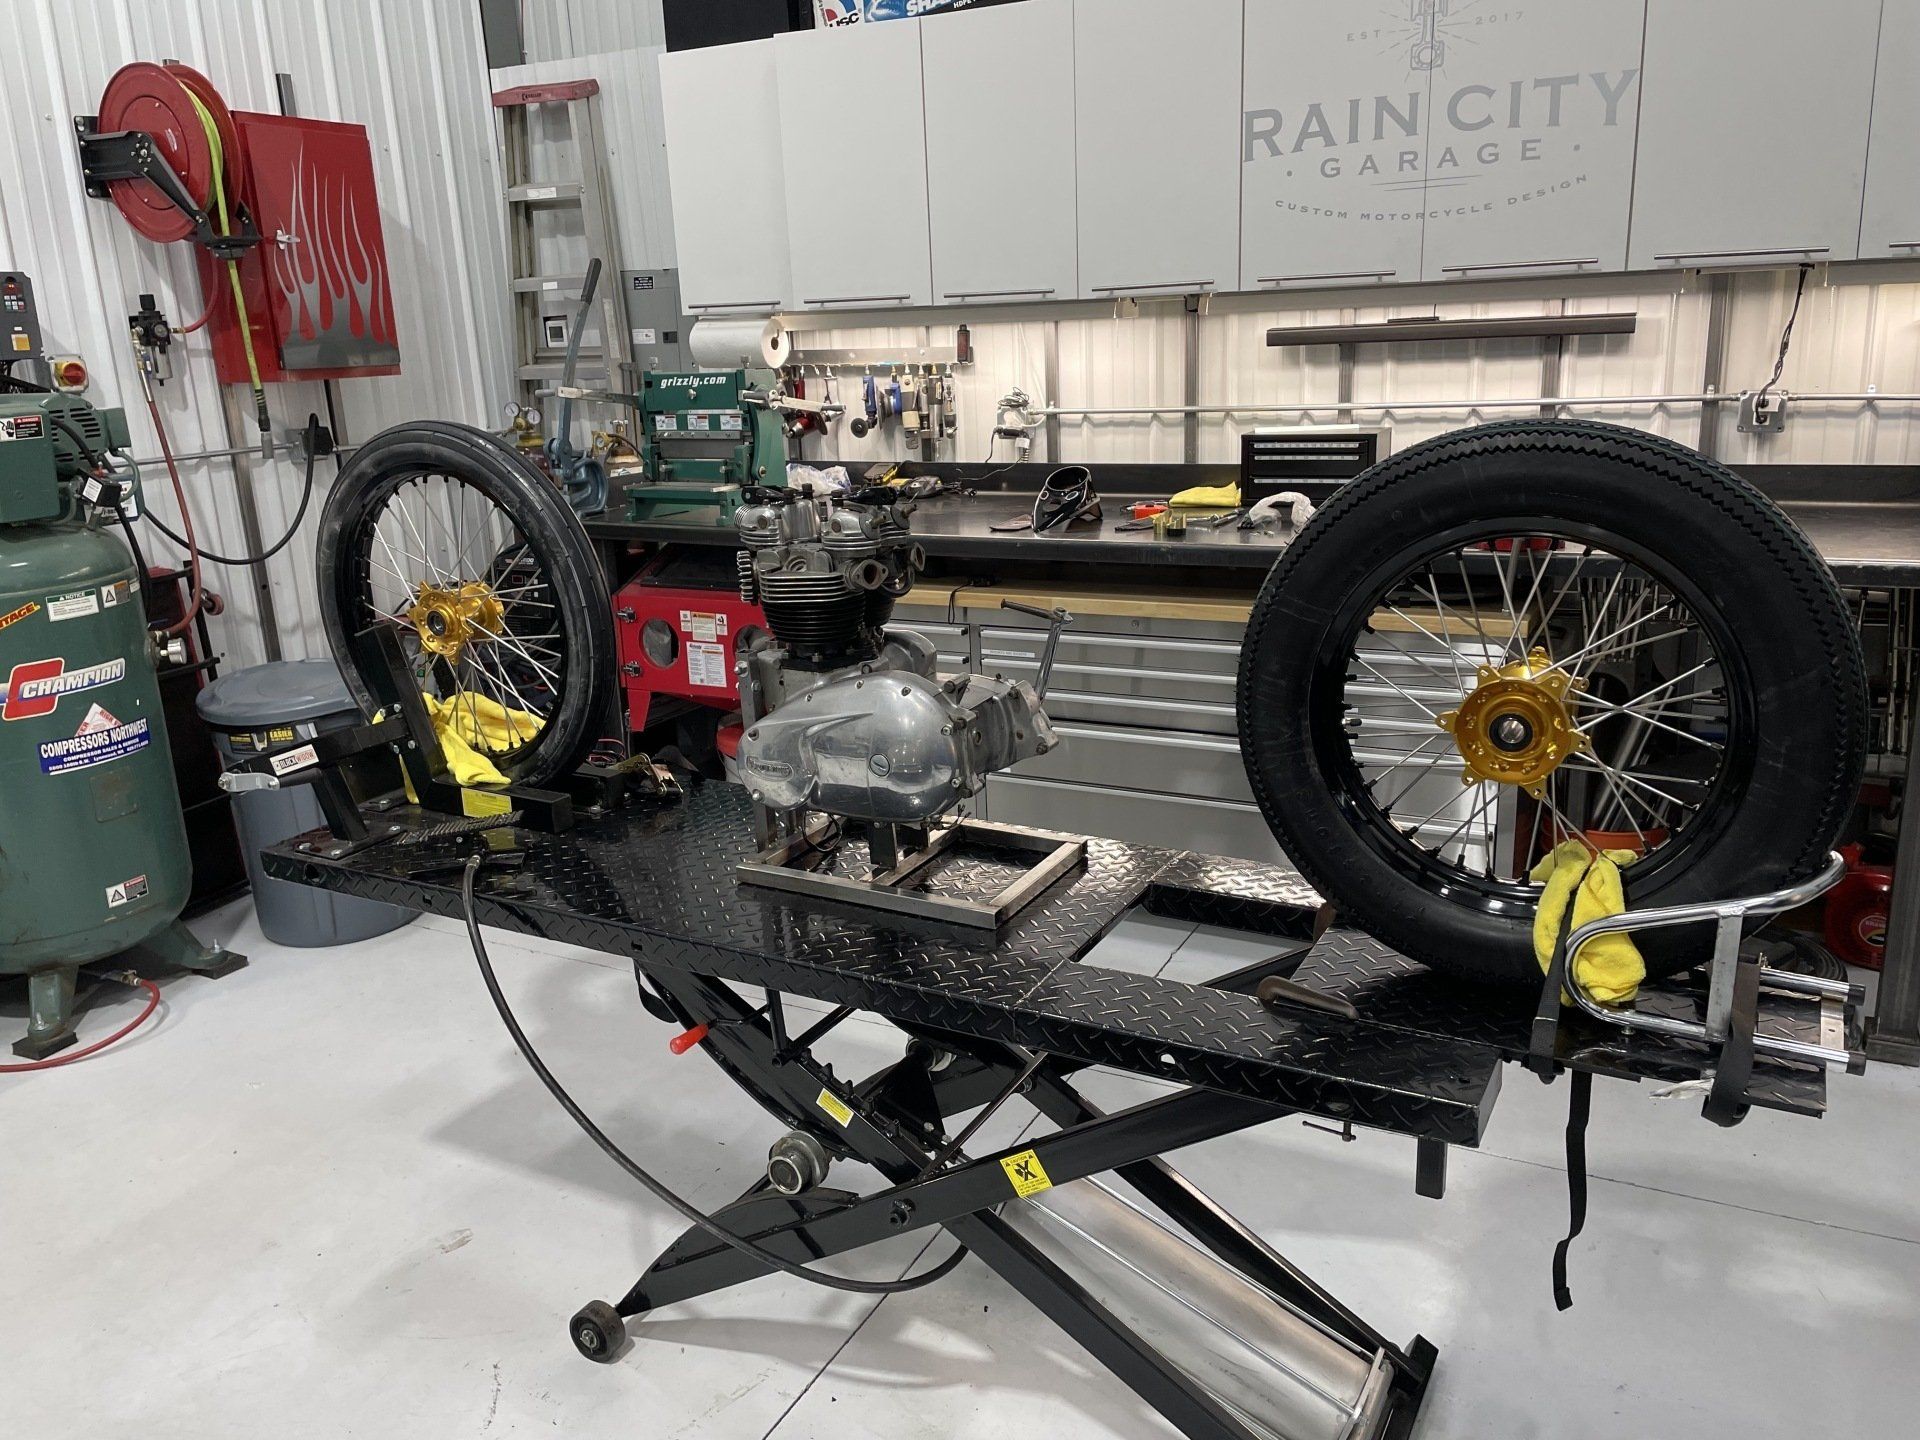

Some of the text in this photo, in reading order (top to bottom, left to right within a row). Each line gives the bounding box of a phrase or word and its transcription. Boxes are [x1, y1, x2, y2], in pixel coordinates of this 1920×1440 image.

[1345, 29, 1382, 42] EST
[1474, 10, 1525, 26] 2017
[1242, 67, 1640, 163] RAIN CITY
[1319, 137, 1543, 179] GARAGE
[1274, 173, 1588, 221] CUSTOM MOTORCYCLE DESIGN
[660, 375, 727, 389] grizzly.com
[22, 662, 122, 699] CHAMPION
[40, 730, 110, 759] COMPRESSORS
[110, 717, 148, 743] NORTHWEST
